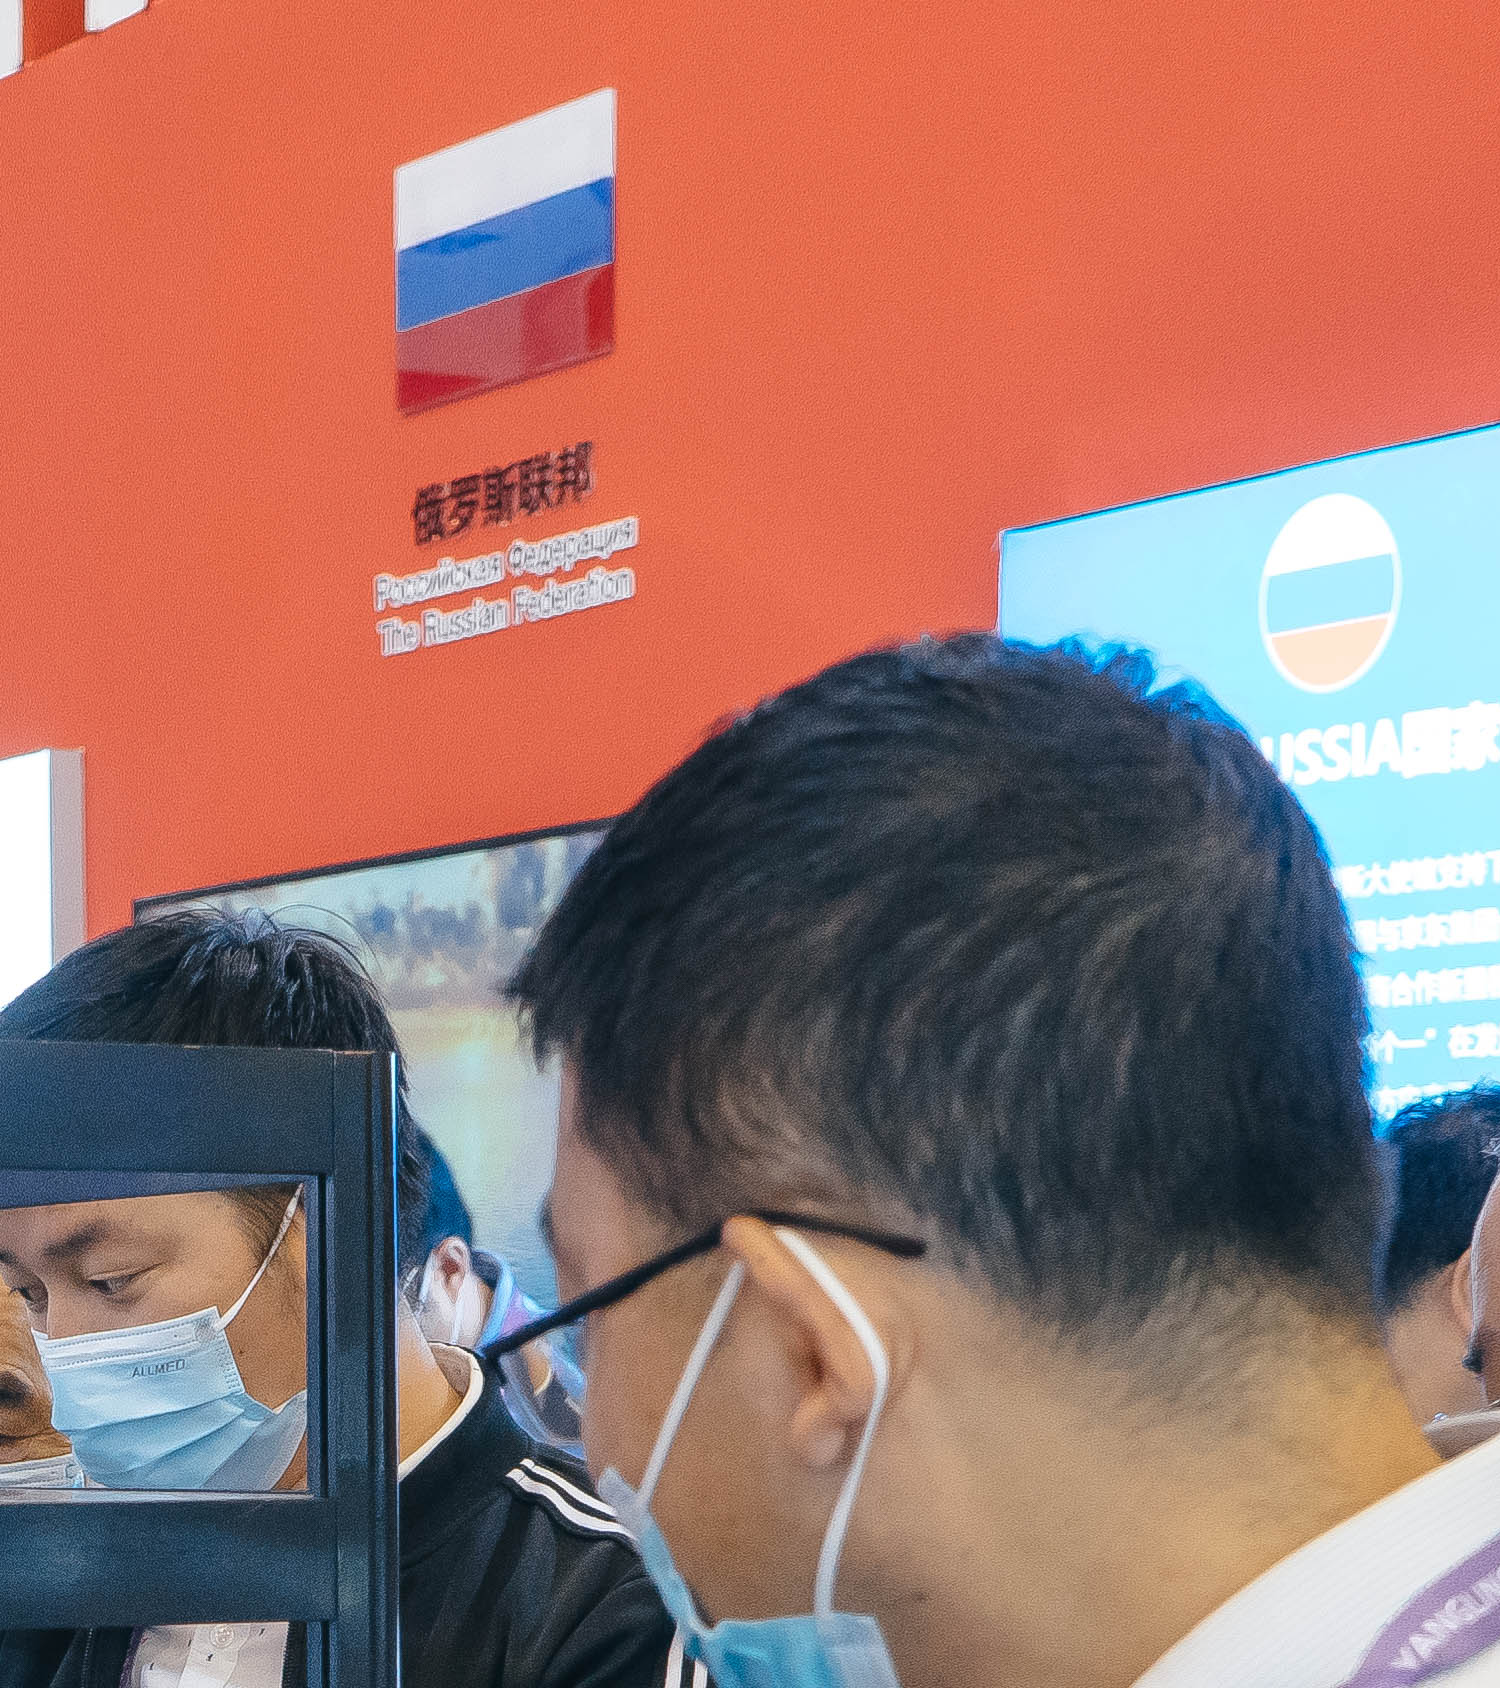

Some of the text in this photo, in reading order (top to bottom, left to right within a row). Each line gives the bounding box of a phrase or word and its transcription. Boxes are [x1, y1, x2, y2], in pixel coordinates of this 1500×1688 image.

[412, 441, 593, 545] 俄罗斯联邦
[374, 516, 639, 611] Российская Федерация
[377, 566, 636, 656] The Russian Federation
[132, 1359, 185, 1377] ALLMED
